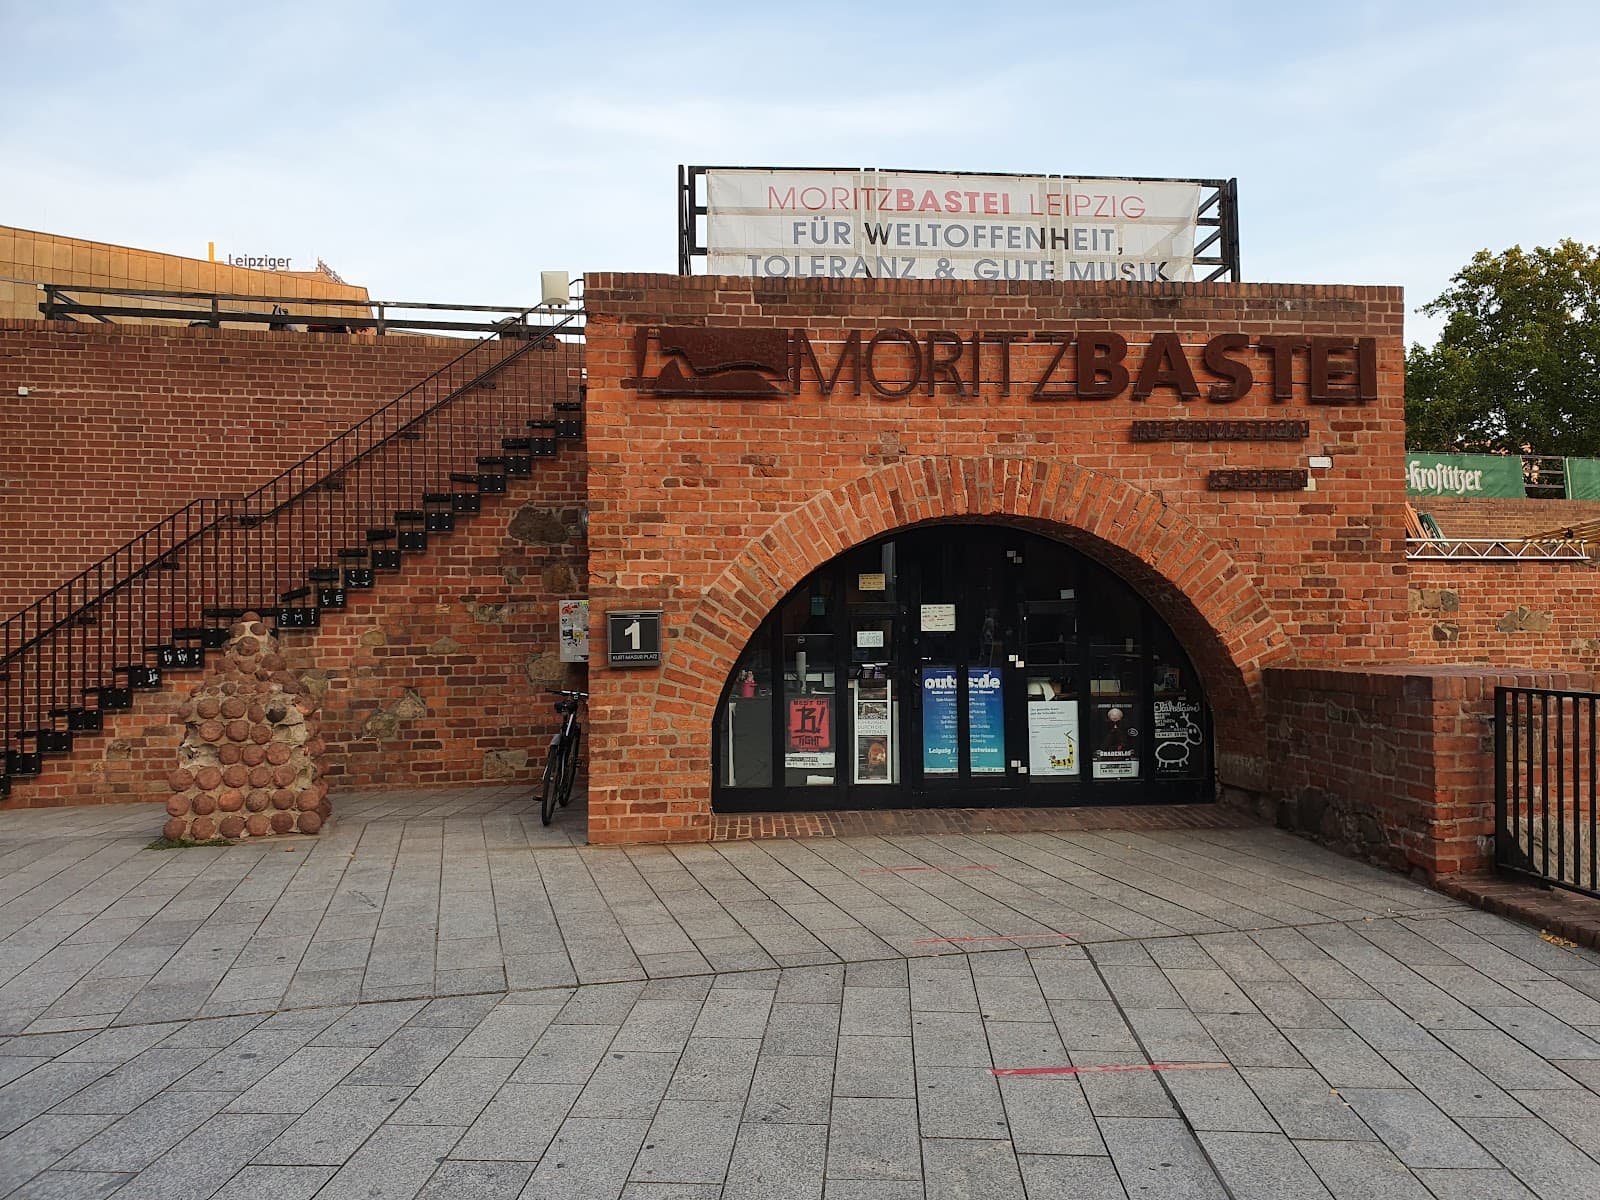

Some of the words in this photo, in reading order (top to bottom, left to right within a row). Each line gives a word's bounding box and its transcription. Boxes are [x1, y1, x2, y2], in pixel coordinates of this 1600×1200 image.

[768, 186, 1010, 215] MORITZBASTEI
[1030, 193, 1146, 219] LEIPZIG
[793, 216, 852, 245] FÜR
[864, 222, 1123, 255] WELTOFFENHEIT,
[228, 253, 292, 271] Leipziger
[747, 254, 917, 280] TOLERANZ
[935, 257, 956, 280] &
[973, 258, 1055, 281] GUTE
[1069, 261, 1169, 282] MUSIK
[792, 327, 1378, 402] MORITZBASTEI
[625, 620, 640, 650] 1
